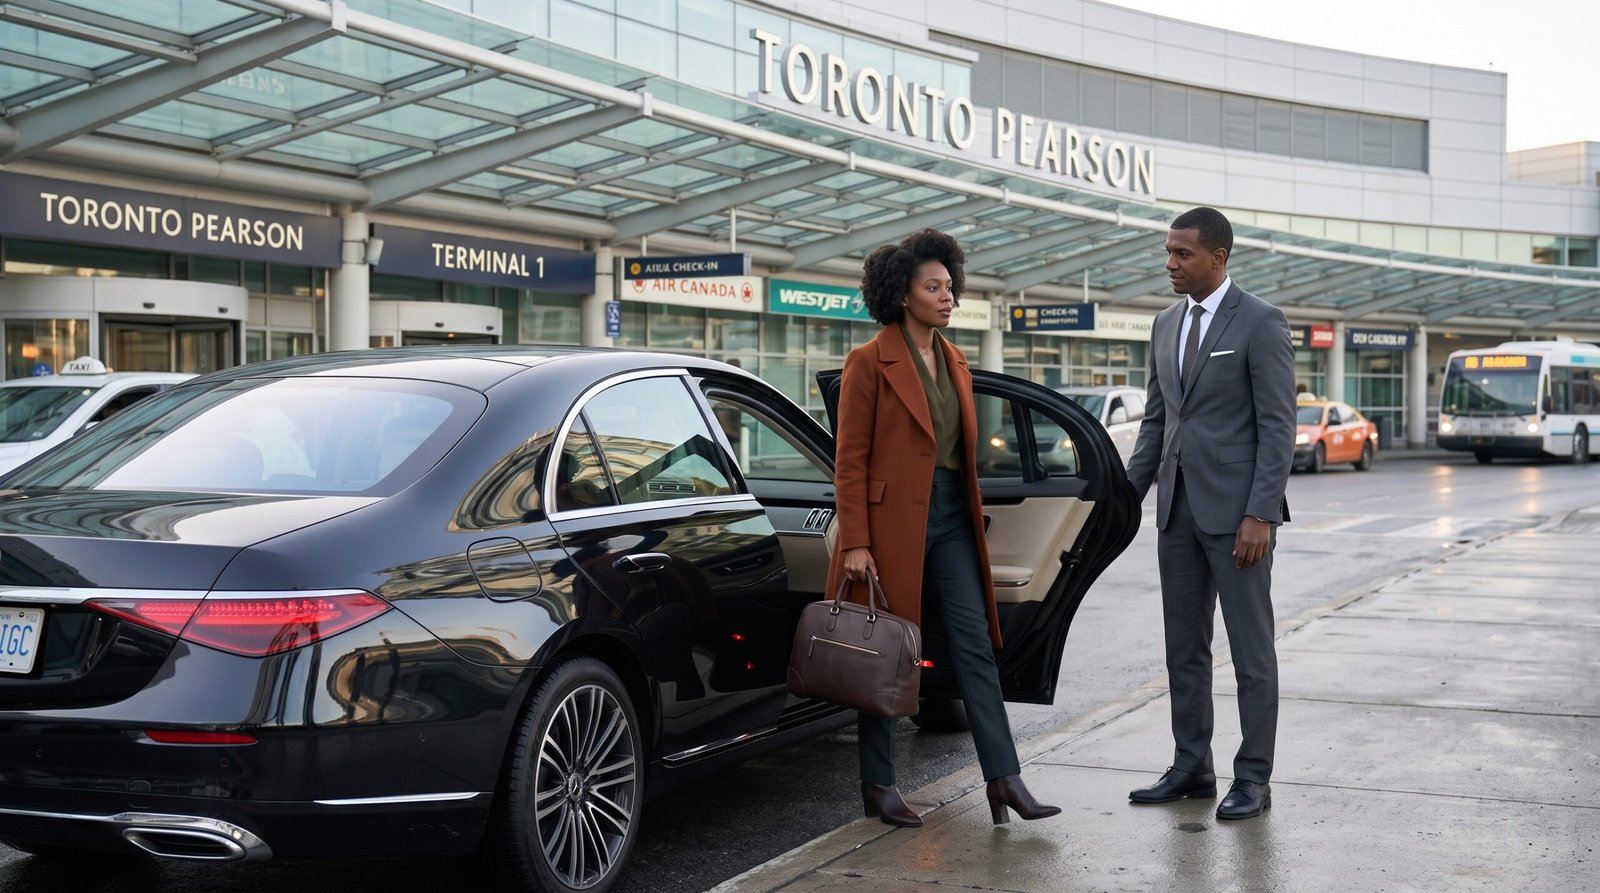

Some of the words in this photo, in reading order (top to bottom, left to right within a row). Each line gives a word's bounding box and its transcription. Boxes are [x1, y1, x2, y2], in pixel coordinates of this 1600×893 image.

[750, 28, 976, 150] TORONTO
[992, 106, 1155, 194] PEARSON
[40, 192, 182, 237] TORONTO
[191, 212, 303, 251] PEARSON
[432, 243, 530, 277] TERMINAL
[536, 256, 544, 278] 1
[672, 261, 718, 272] CHECK-IN
[653, 278, 676, 292] AIR
[680, 279, 736, 298] CANADA
[779, 288, 851, 311] WESTJET
[1040, 307, 1079, 317] CHECK-IN
[69, 363, 90, 371] TAXI
